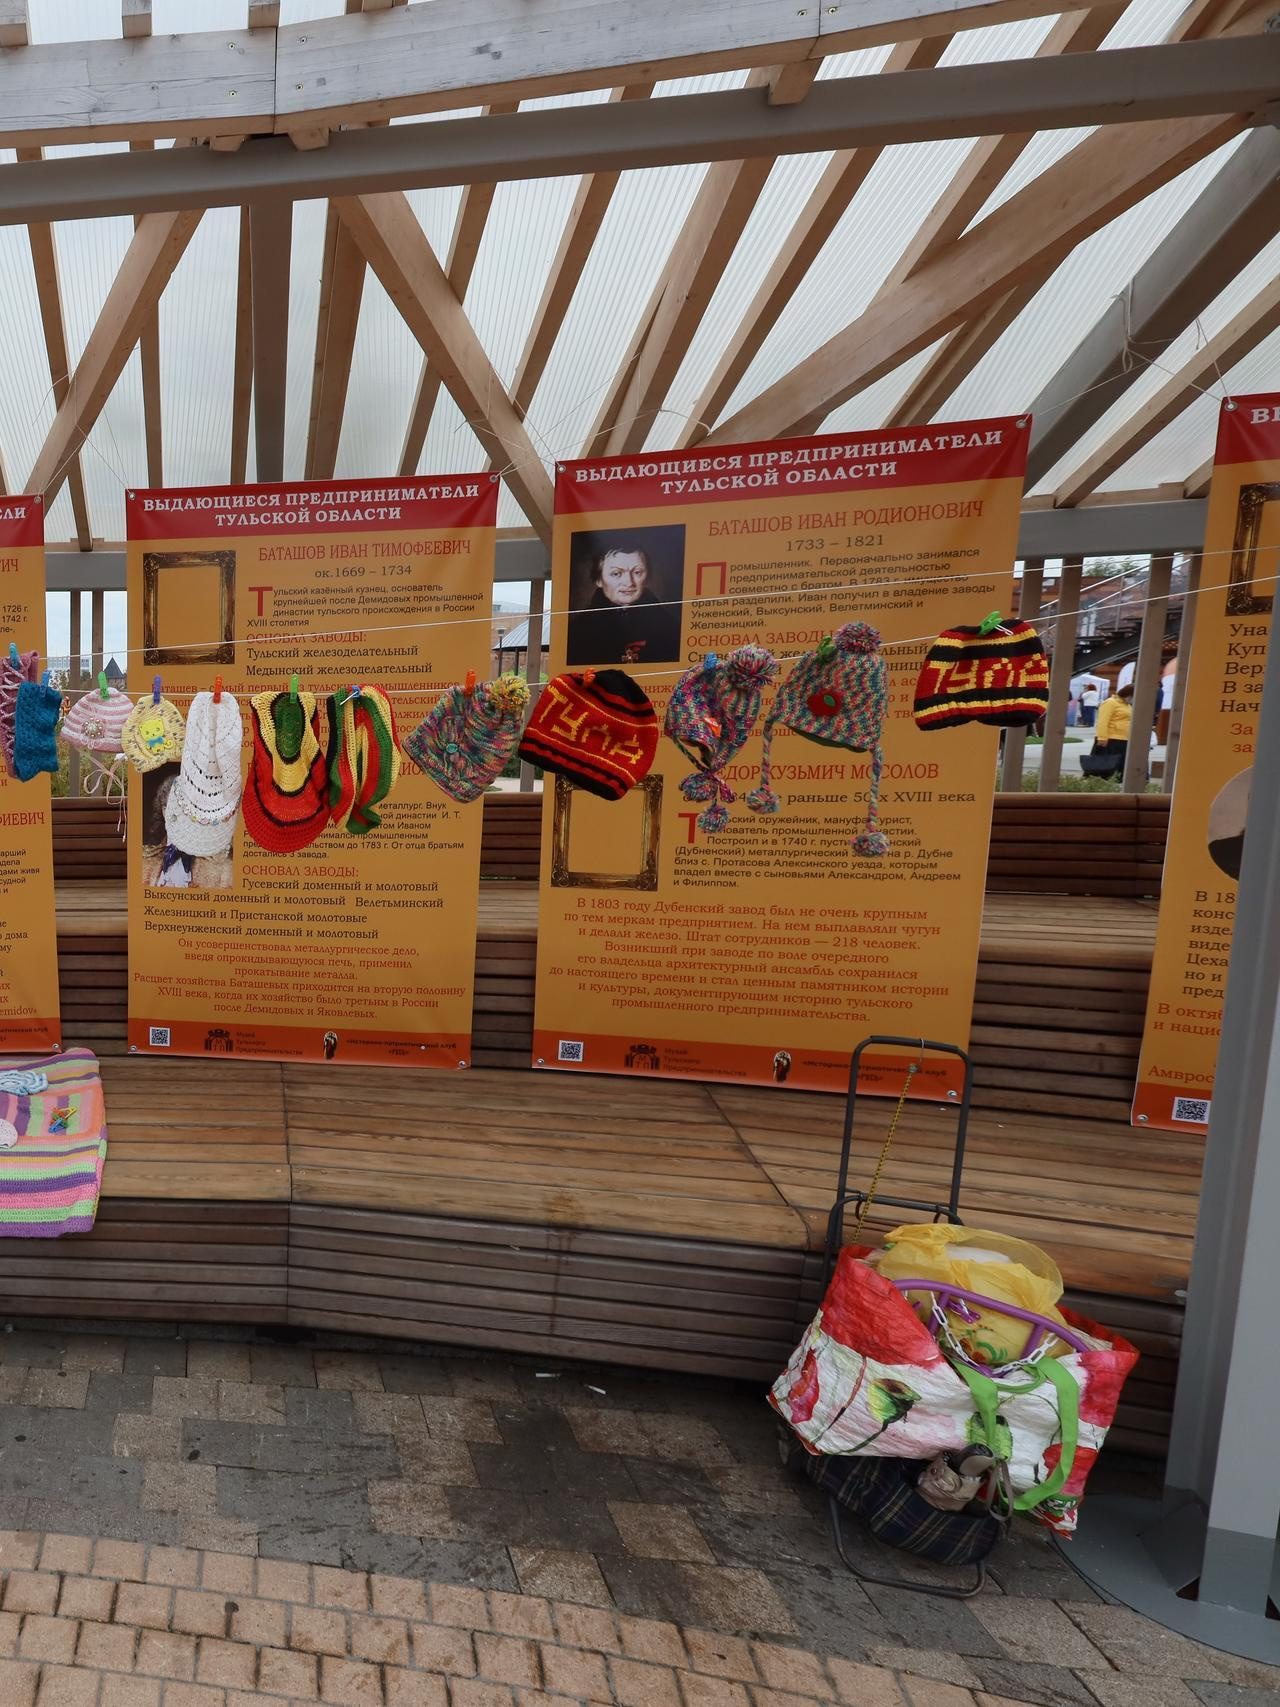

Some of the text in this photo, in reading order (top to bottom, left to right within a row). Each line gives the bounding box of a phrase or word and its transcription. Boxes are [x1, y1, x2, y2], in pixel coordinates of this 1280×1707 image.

[576, 431, 1002, 482] ВЫДАЮЩИЕСЯ ПРЕДПРИНИМАТЕЛИ
[661, 462, 897, 494] ТУЛЬСКОЙ ОБЛАСТИ
[143, 485, 479, 511] ВЫДАЮЩИЕСЯ ПРЕДПРИНИМАТЕЛИ
[215, 507, 401, 526] ТУЛЬСКОЙ ОБЛАСТИ
[708, 501, 984, 536] БАТАШОВ ИВАН РОДИОНОВИЧ
[258, 540, 470, 561] БАТАШОВ ИВАН ТИМОФЕЕВИЧ
[787, 538, 825, 551] 1733
[846, 534, 883, 548] 1821
[315, 567, 366, 578] ок.1669
[382, 565, 412, 576] 1734
[729, 563, 951, 583] предпринимательской деятельностью
[247, 619, 267, 627] XVIII
[246, 646, 418, 661] Тульский железоделательный
[1224, 661, 1265, 677] Вер
[1223, 680, 1237, 694] В
[787, 791, 848, 806] раньше
[892, 791, 933, 804] XVIII
[938, 793, 976, 803] века
[242, 865, 359, 879] ОСНОВАЛ ЗАВОДЫ:
[144, 889, 443, 908] Выксунский доменный и молотовый Велетьминский
[1195, 891, 1208, 902] В
[577, 897, 928, 921] В 1803 году Дубенский завод был не очень крупным
[145, 921, 242, 935] Верхнеунженский
[245, 928, 303, 937] доменный
[317, 930, 378, 939] молотовый
[1191, 925, 1233, 936] изде
[1184, 971, 1205, 981] но
[214, 1004, 242, 1012] после
[244, 1004, 304, 1015] Демидовых
[612, 999, 870, 1021] промышленного предпринимательства.
[1157, 1003, 1170, 1015] В
